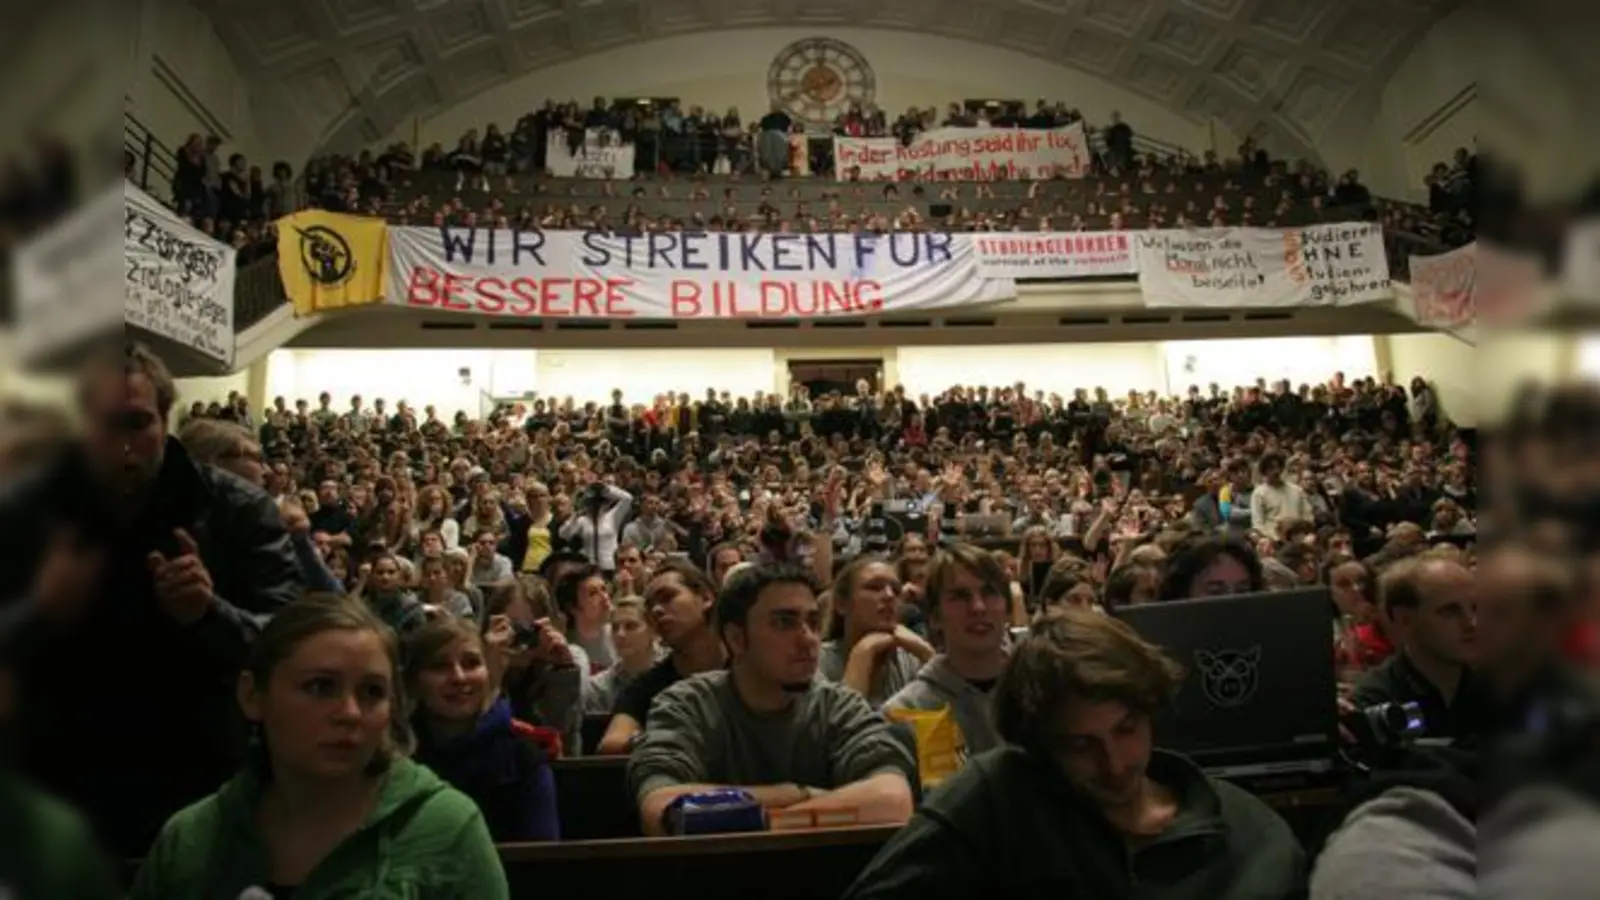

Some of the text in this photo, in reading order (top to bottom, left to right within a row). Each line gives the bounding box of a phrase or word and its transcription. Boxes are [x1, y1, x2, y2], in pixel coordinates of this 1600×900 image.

[440, 226, 546, 266] WIR
[582, 230, 837, 271] STREIKEN
[407, 266, 883, 317] BESSERE BILDUNG
